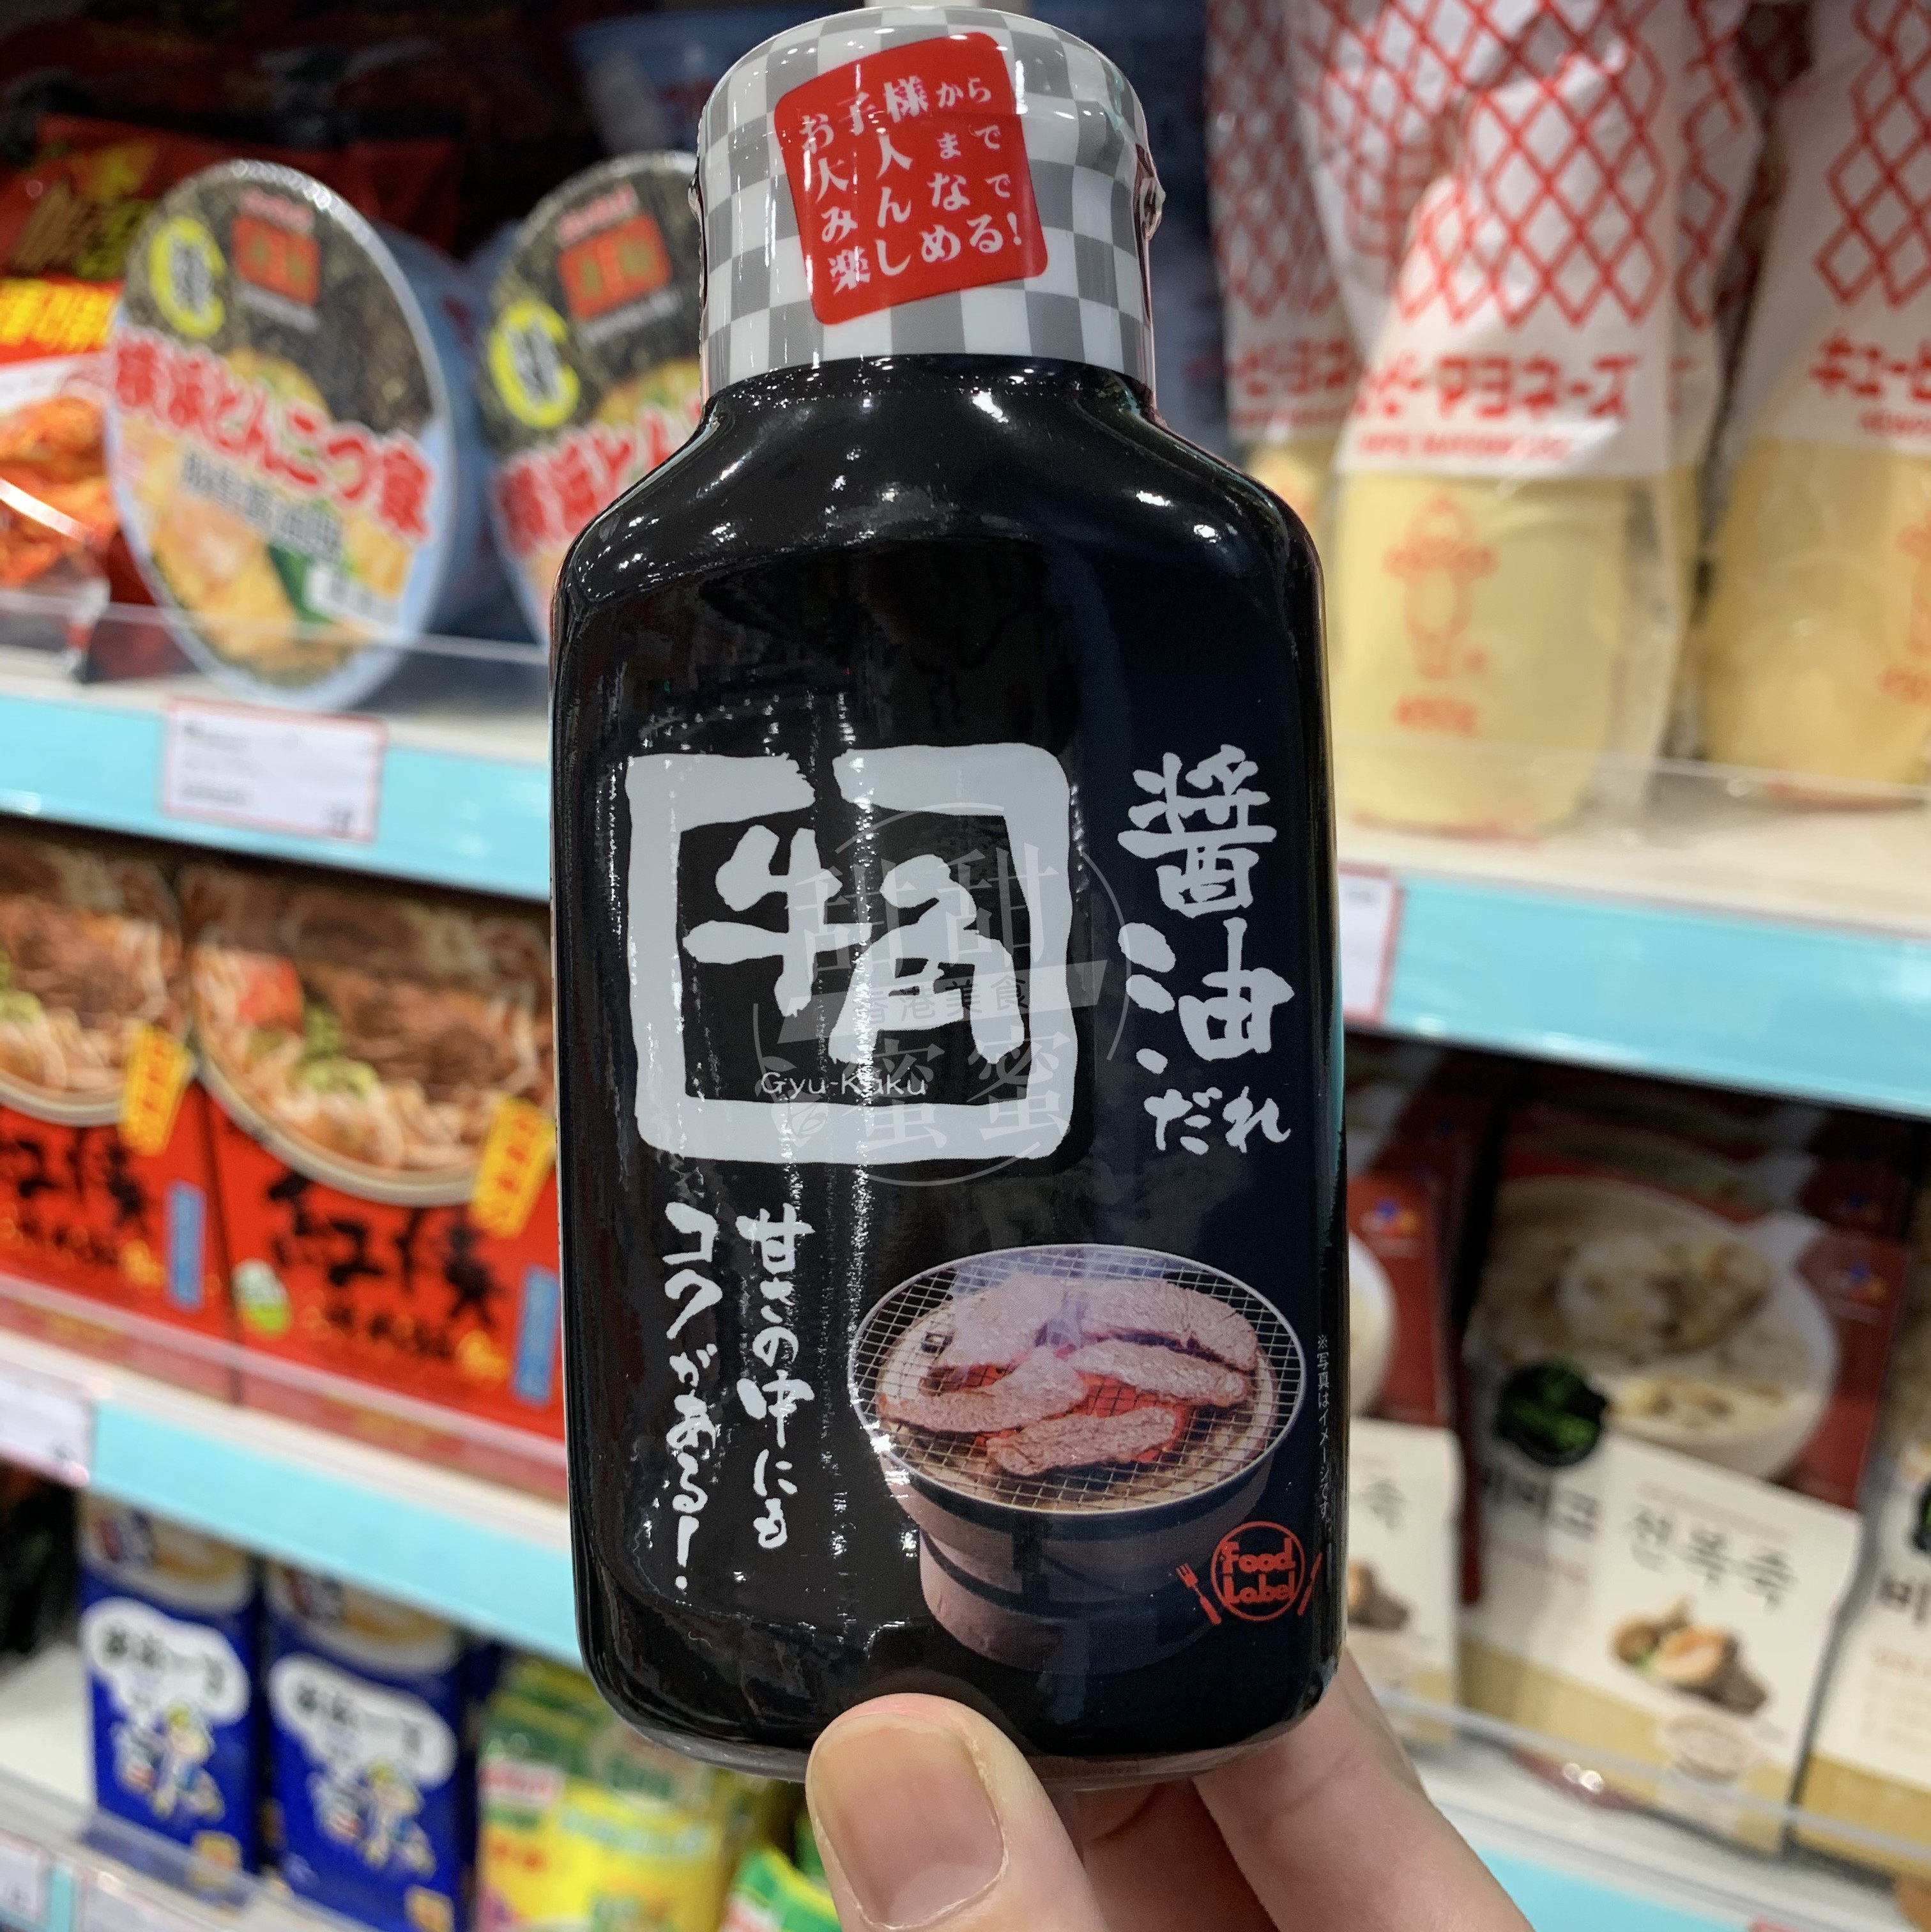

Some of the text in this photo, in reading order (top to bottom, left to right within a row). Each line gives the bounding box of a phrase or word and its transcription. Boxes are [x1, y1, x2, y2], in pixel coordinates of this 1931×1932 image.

[798, 75, 992, 154] お子様から
[815, 125, 1002, 203] 大人まで
[821, 172, 1012, 243] みんなで
[828, 212, 1023, 295] 楽しめる!
[682, 823, 1025, 1065] 牛角
[735, 1203, 816, 1549] 甘さの中にも
